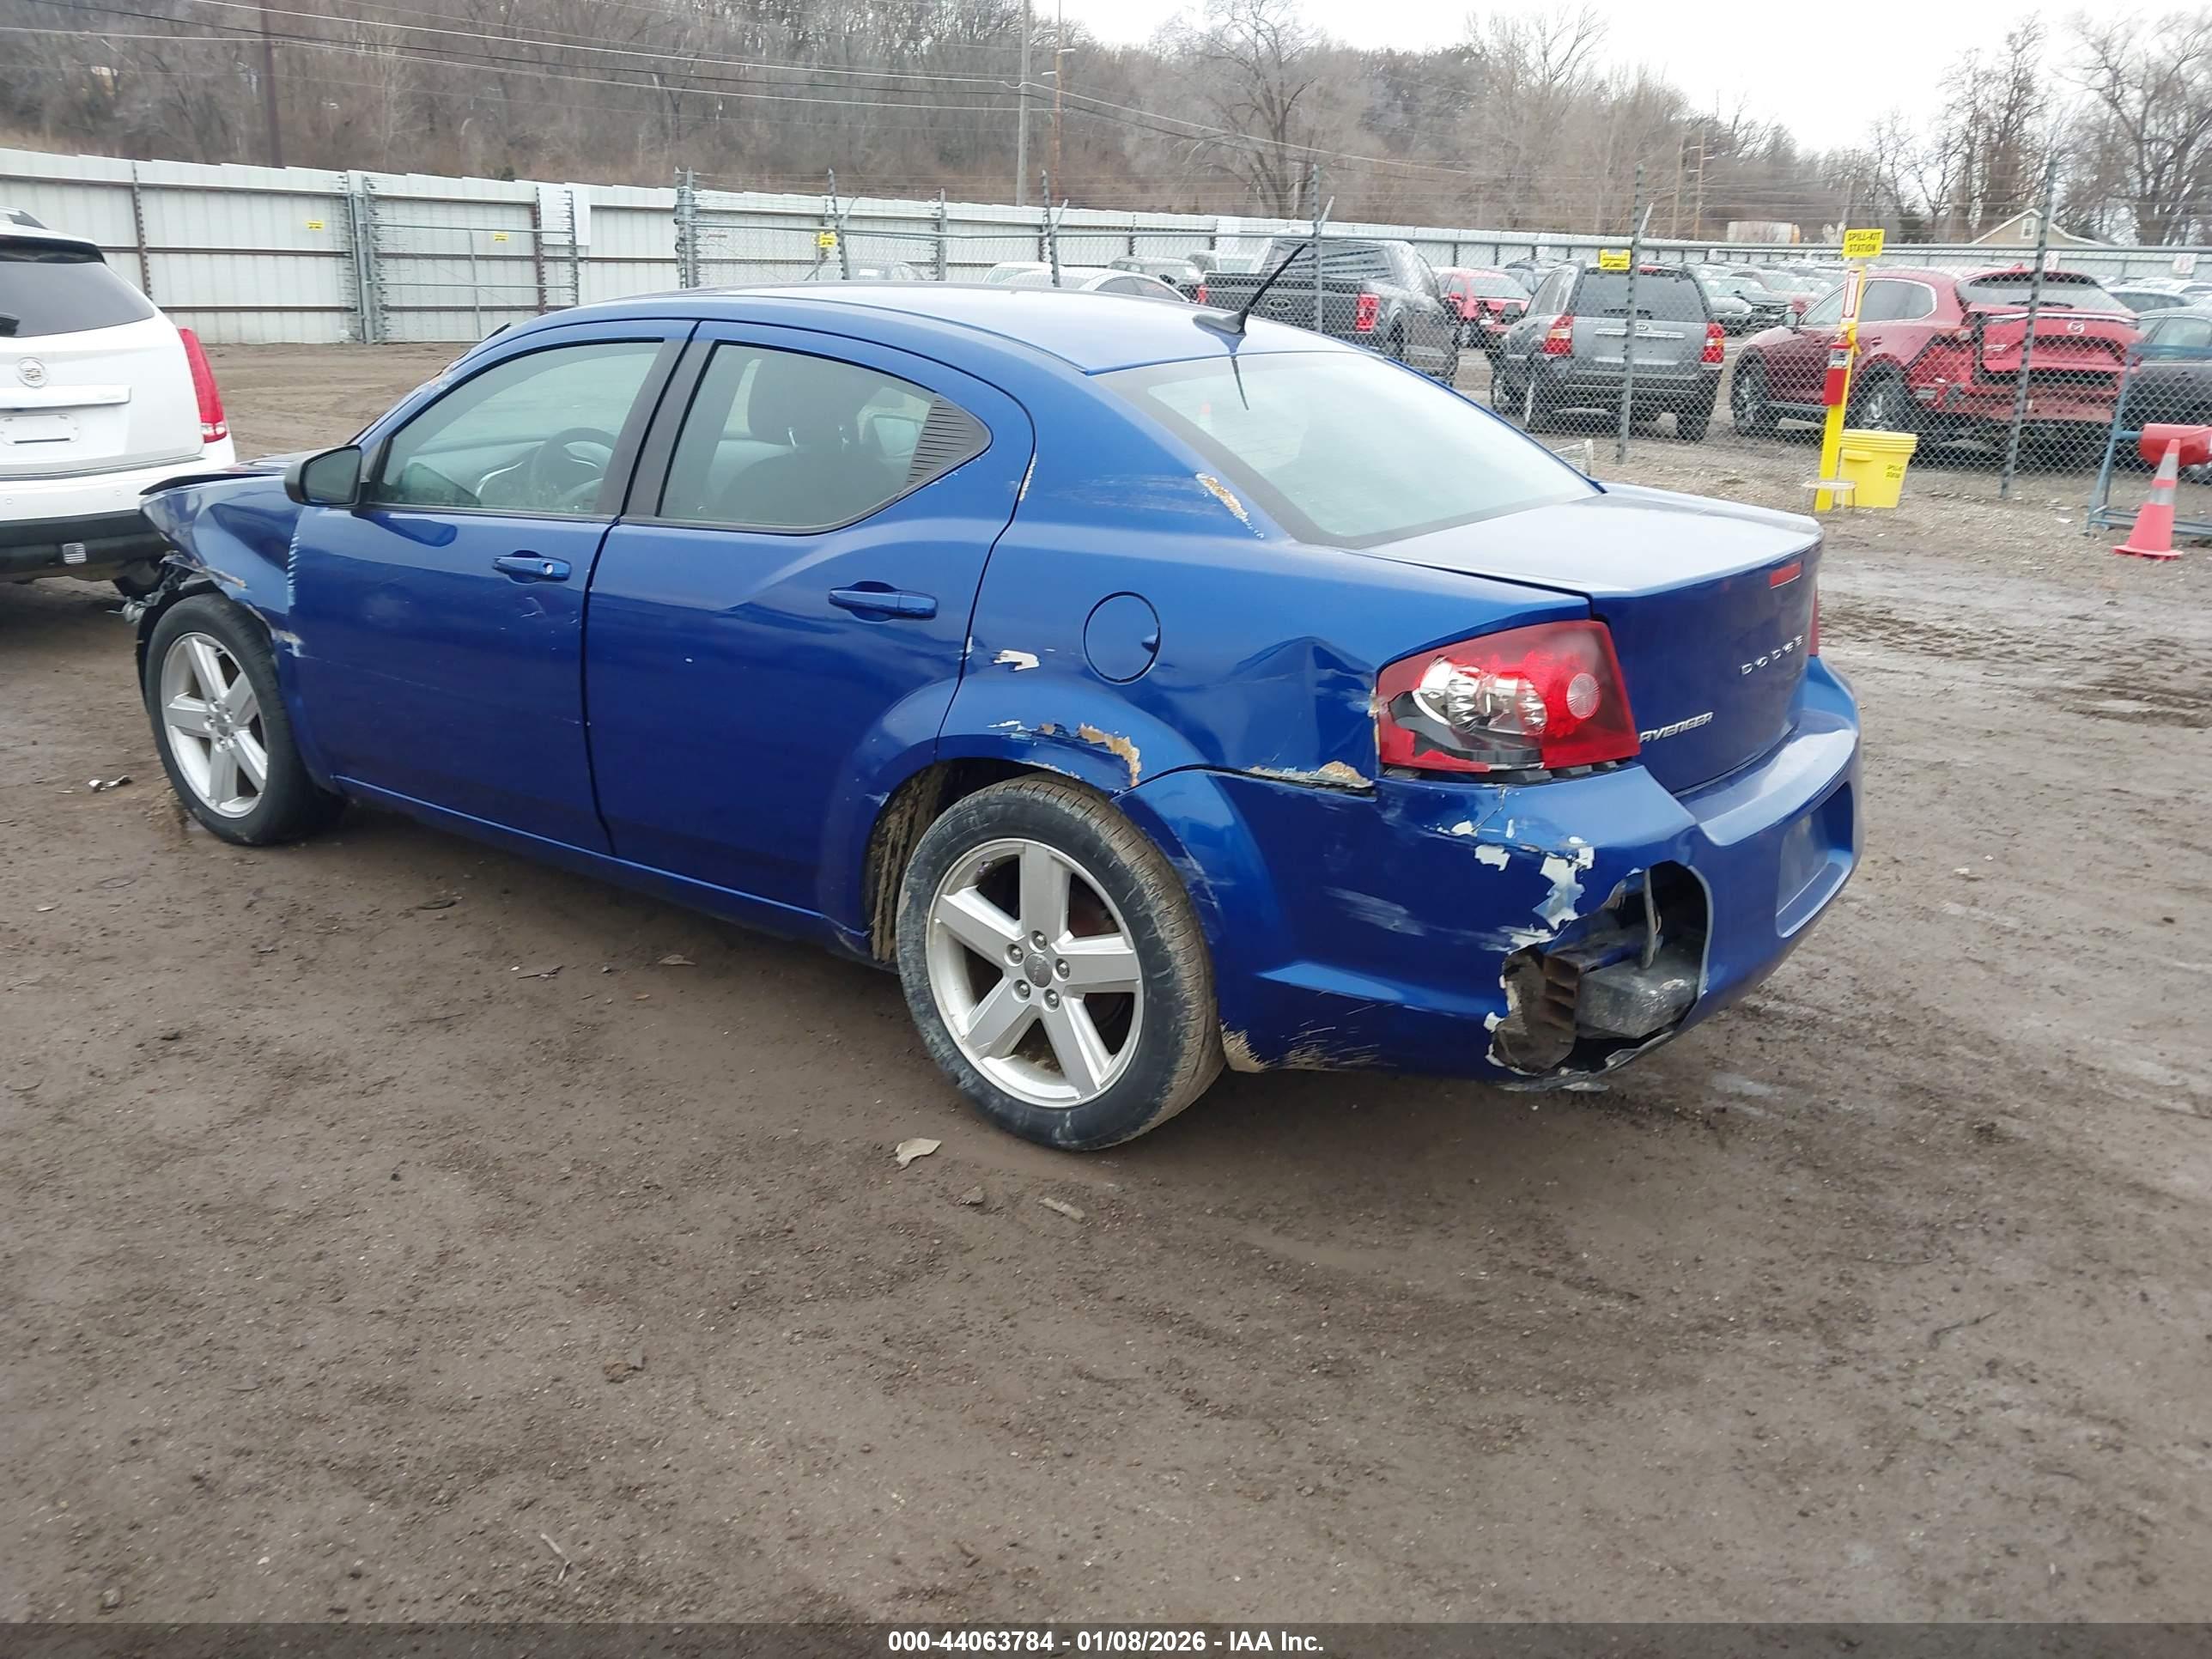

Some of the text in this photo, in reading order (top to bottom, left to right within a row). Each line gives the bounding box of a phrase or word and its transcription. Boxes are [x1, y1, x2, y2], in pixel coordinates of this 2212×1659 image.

[1848, 244, 1876, 252] STATION
[1740, 635, 1804, 676] DODGE
[1638, 711, 1714, 744] AVENGER
